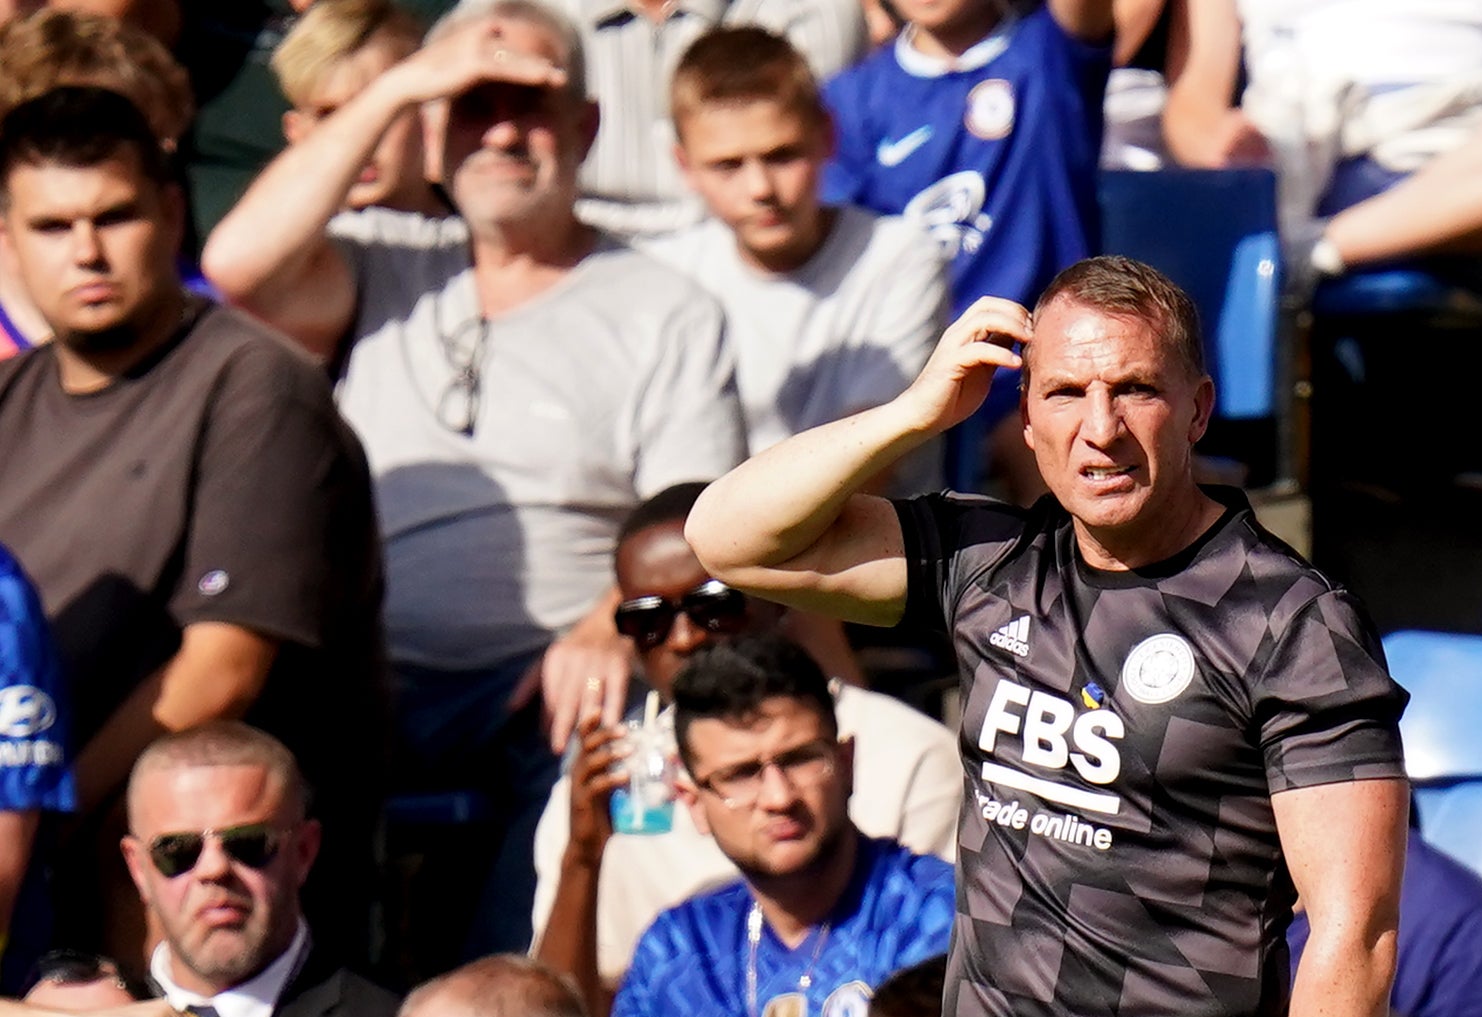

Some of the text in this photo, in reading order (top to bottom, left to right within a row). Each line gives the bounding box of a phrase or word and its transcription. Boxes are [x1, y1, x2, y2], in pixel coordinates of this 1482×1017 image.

[989, 632, 1030, 657] adidas
[979, 678, 1125, 785] FBS
[1031, 809, 1113, 850] online
